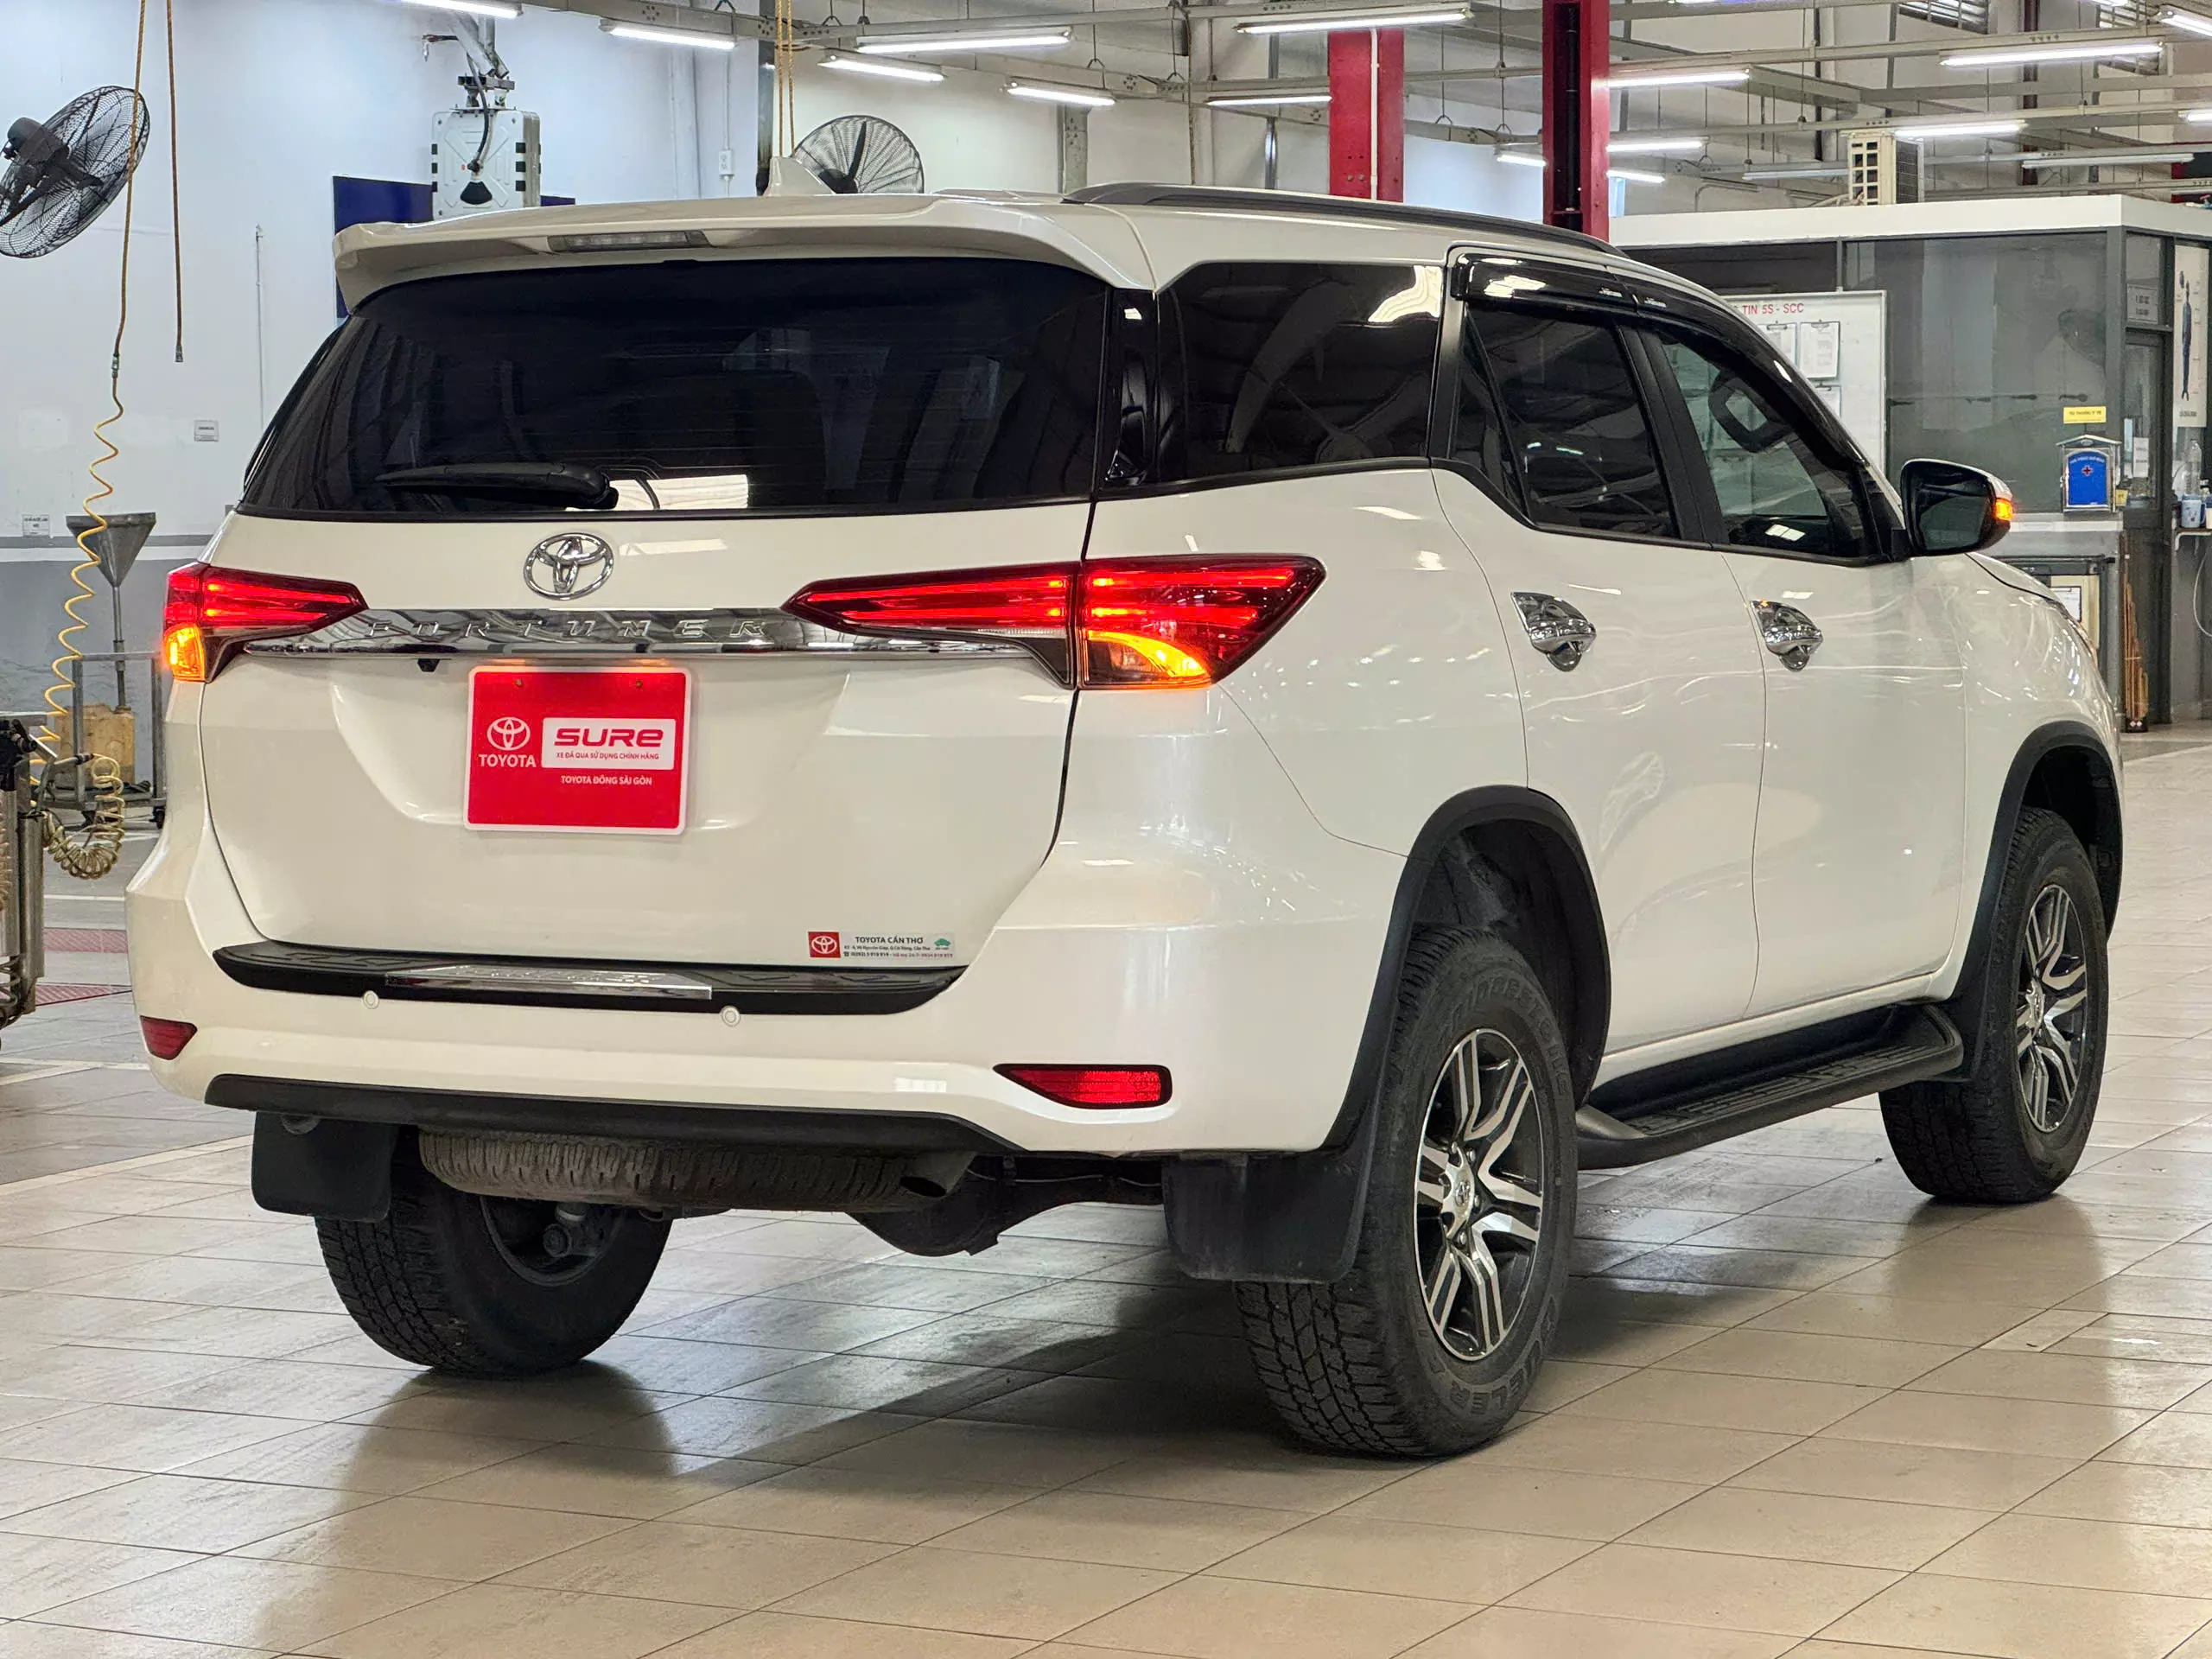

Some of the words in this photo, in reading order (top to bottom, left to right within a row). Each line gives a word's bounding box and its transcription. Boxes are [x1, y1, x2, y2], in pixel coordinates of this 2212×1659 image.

[1742, 304, 1758, 315] TIN
[1762, 303, 1774, 315] 5S
[1783, 302, 1805, 314] SCC
[478, 753, 537, 768] TOYOTA
[599, 752, 619, 761] DỤNG
[619, 751, 639, 760] CHÍNH
[561, 775, 592, 785] TOYOTA
[592, 774, 619, 785] ĐÔNG
[632, 774, 652, 785] GÒN
